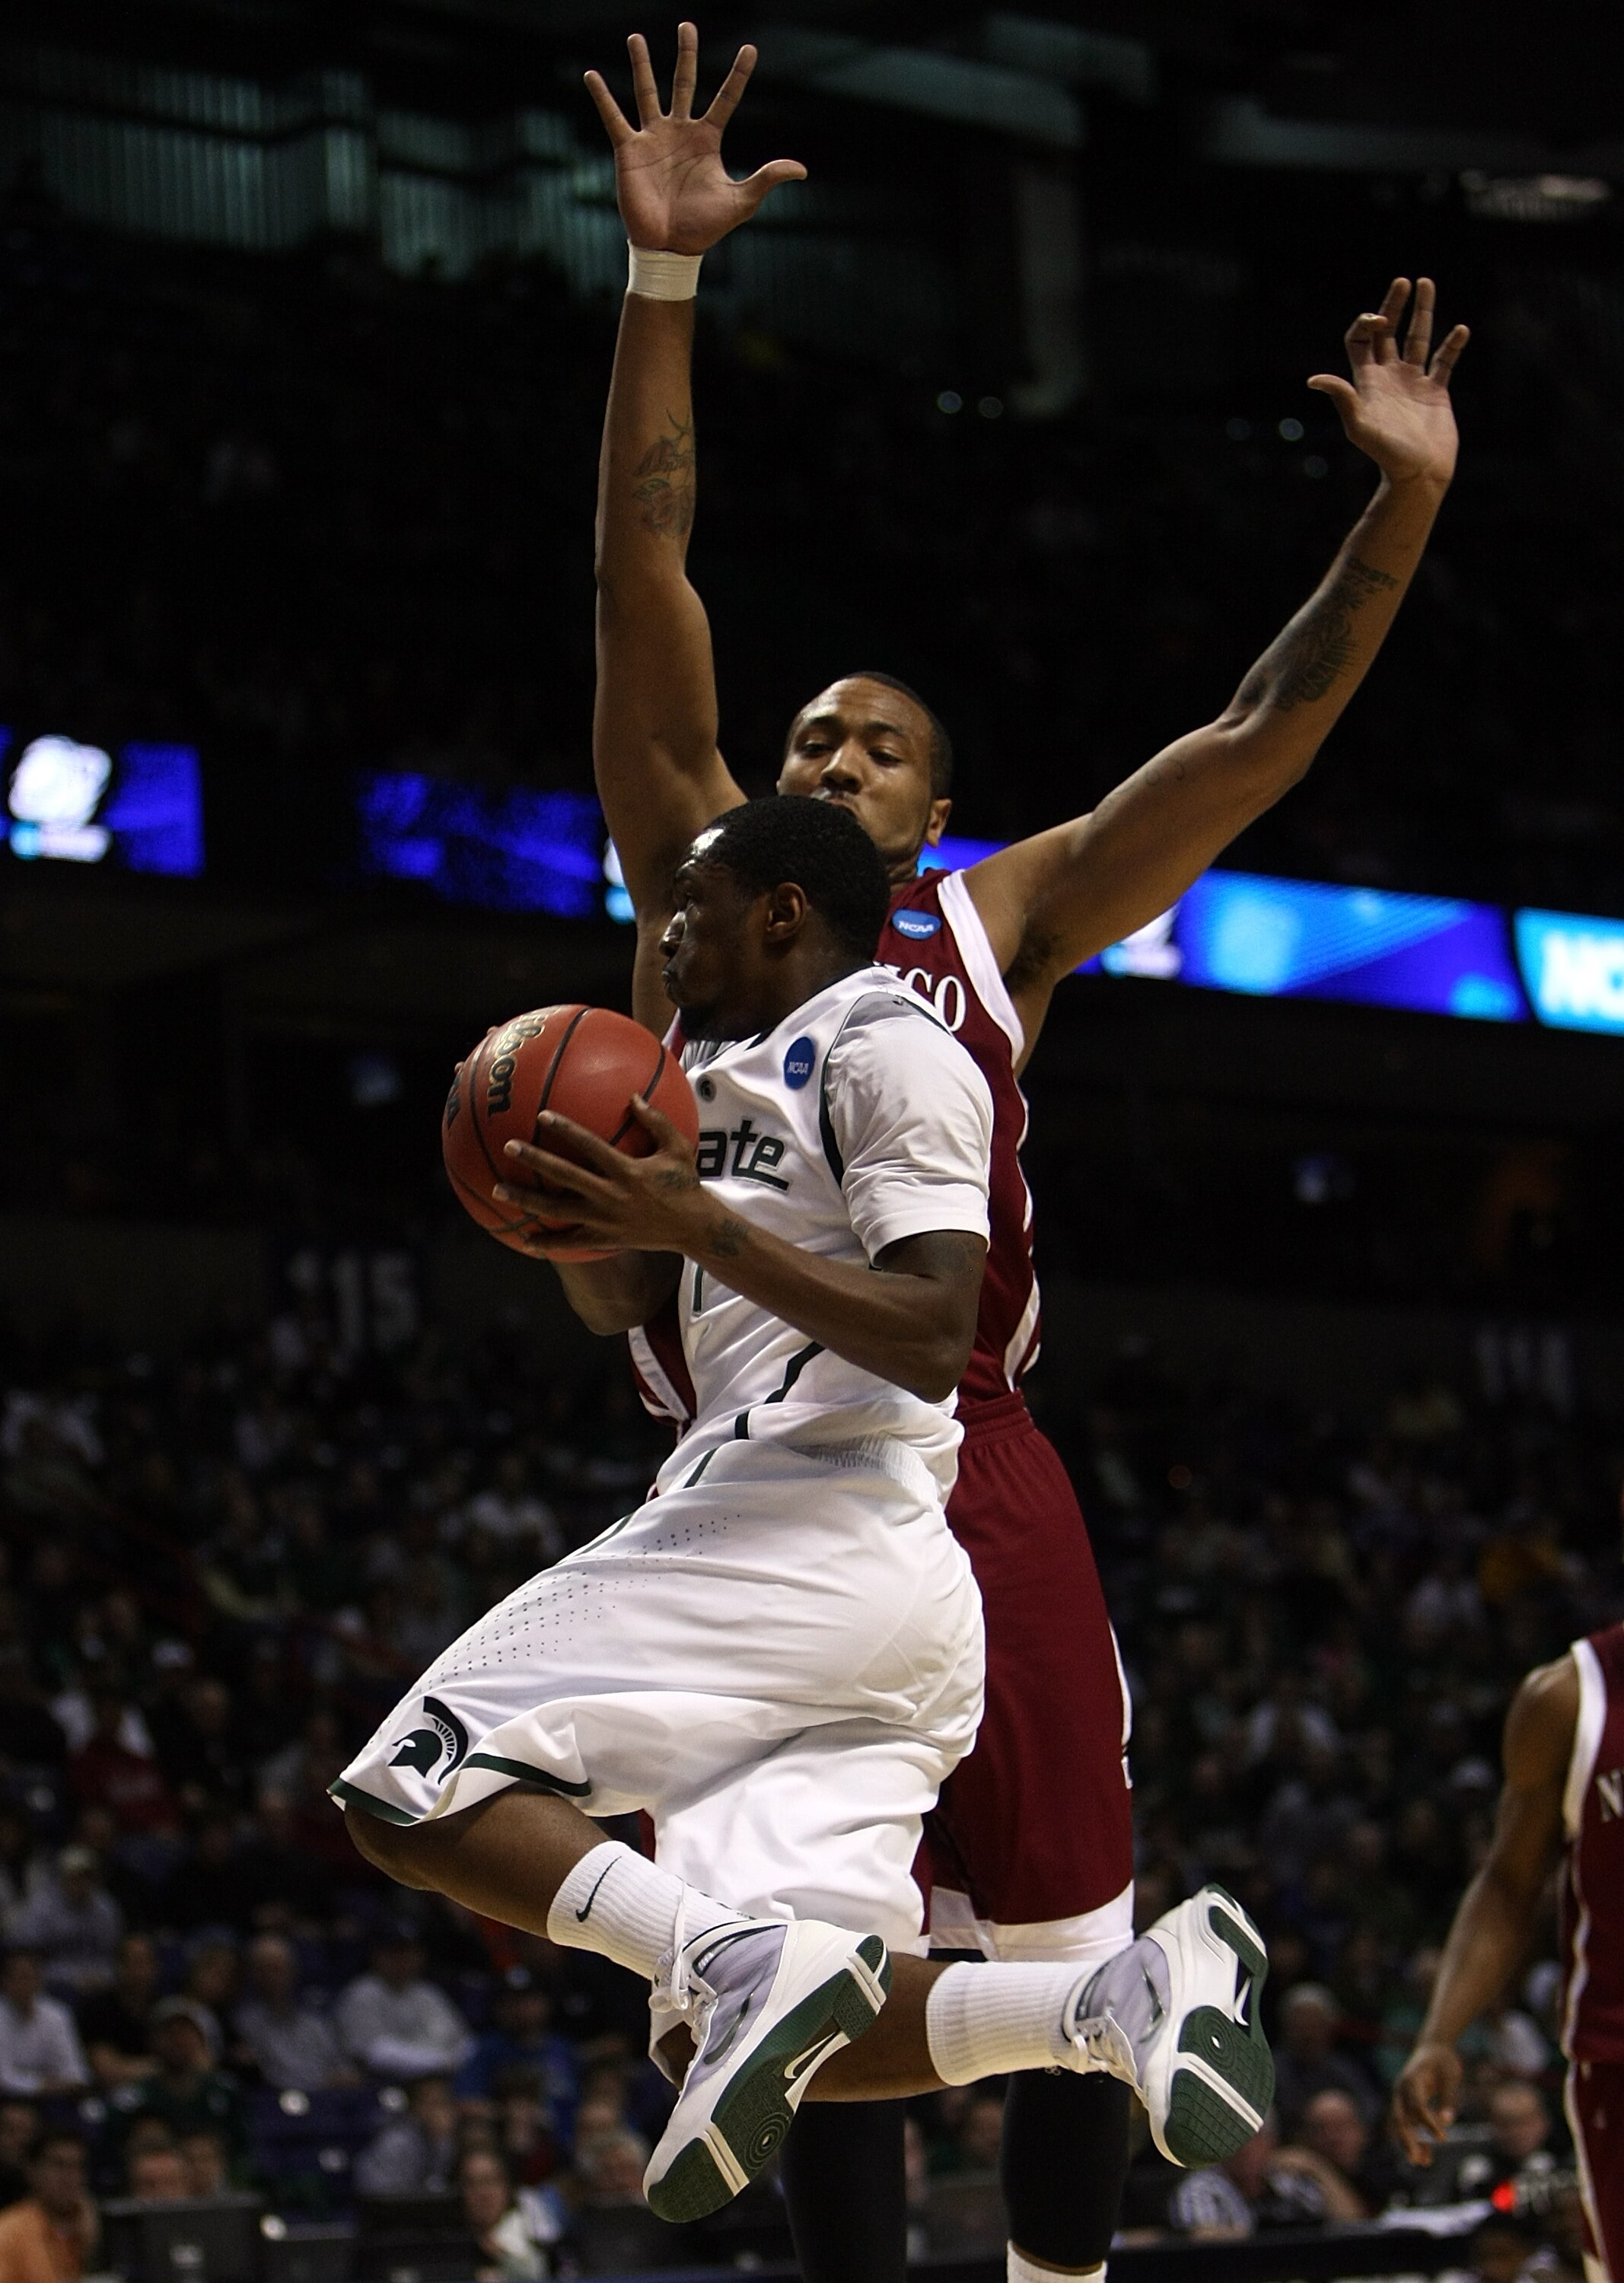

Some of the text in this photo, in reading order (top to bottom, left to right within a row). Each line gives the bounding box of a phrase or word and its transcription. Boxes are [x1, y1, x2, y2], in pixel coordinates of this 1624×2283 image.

[898, 920, 935, 933] NCAA
[787, 1061, 809, 1075] NCAA
[696, 1119, 791, 1192] ate
